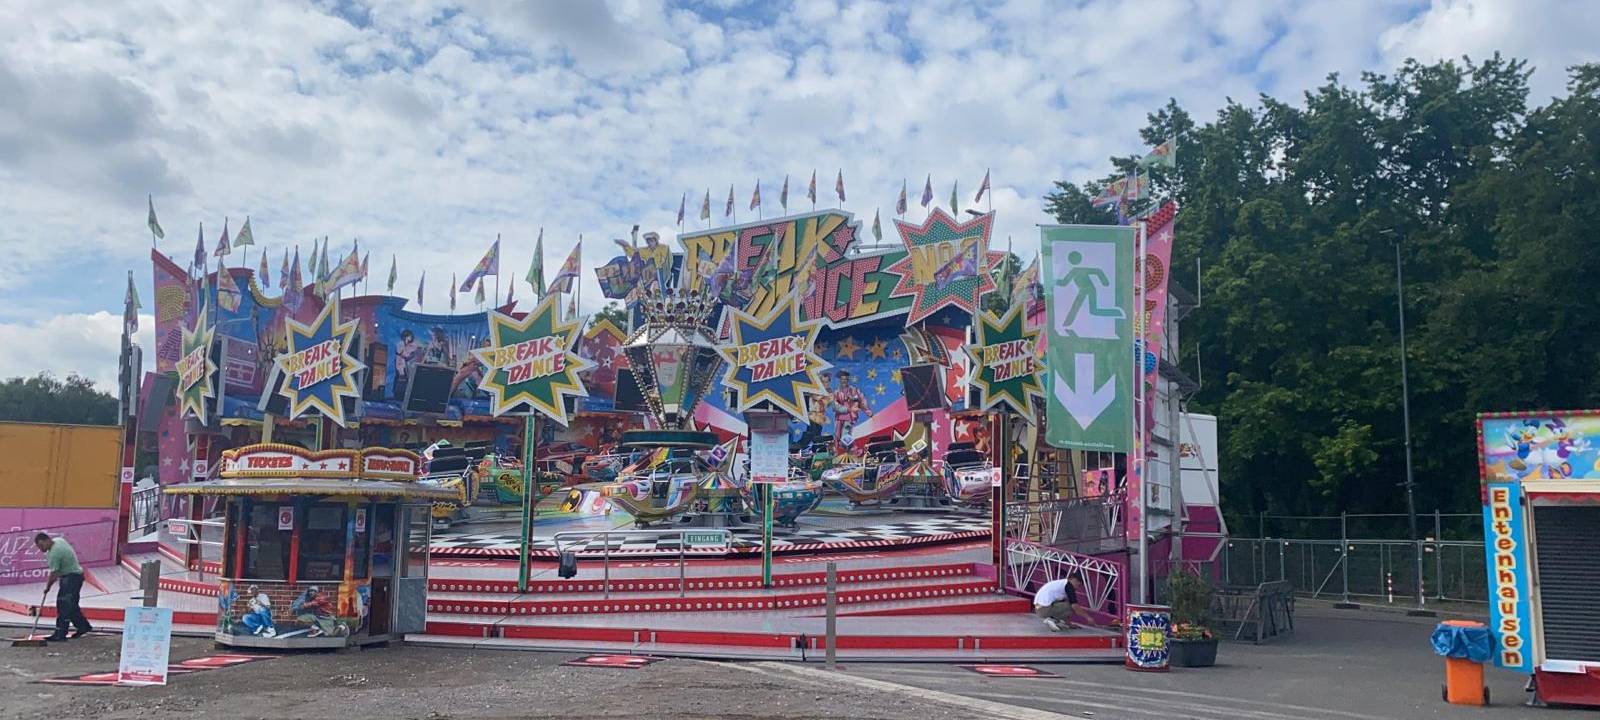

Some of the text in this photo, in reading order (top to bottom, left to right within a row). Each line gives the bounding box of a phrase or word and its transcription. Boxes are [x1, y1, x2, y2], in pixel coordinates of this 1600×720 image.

[289, 341, 332, 373] BREAK
[496, 337, 552, 369] BREAK
[739, 337, 794, 366] BREAK
[984, 341, 1026, 366] BREAK
[299, 355, 340, 388] DANCE
[508, 353, 564, 383] DANCE
[753, 353, 806, 381] DANCE
[994, 356, 1033, 381] DANCE
[247, 456, 293, 468] TICKETS
[1492, 488, 1522, 666] Entenhausen
